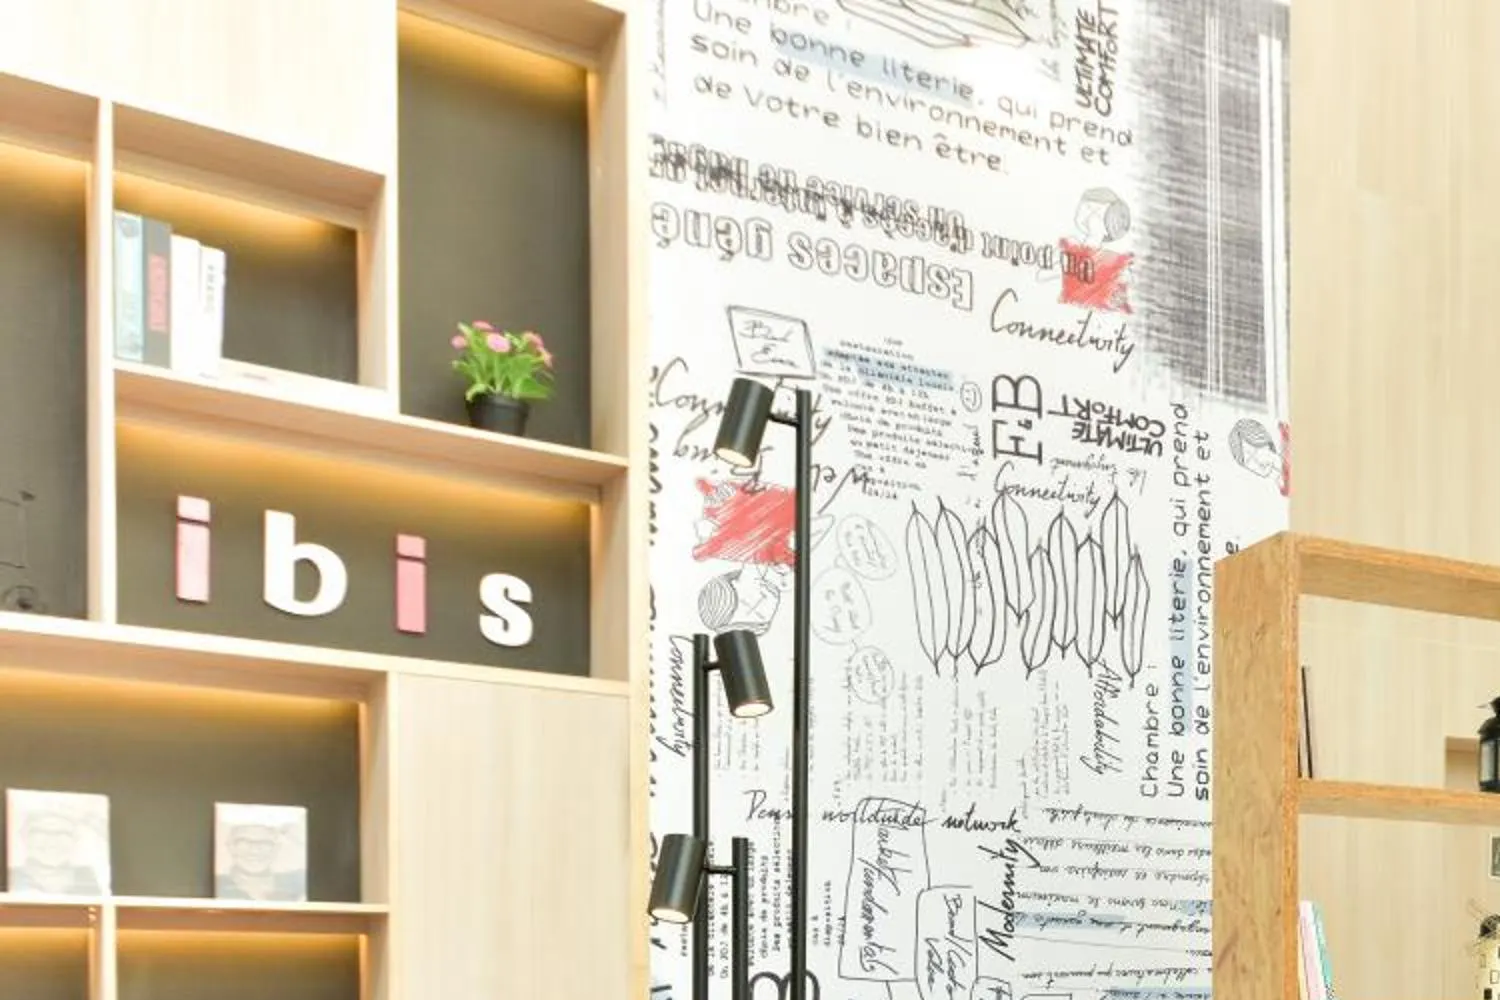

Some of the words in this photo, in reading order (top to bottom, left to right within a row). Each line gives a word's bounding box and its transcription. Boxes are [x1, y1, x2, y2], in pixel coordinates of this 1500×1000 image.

[689, 33, 758, 66] soin
[773, 58, 810, 81] de
[1081, 145, 1110, 166] et
[693, 74, 732, 99] de
[743, 84, 840, 128] Votre
[856, 112, 923, 152] bien
[770, 22, 865, 67] bonne
[998, 95, 1038, 119] qui
[1049, 110, 1133, 147] prend
[991, 288, 1135, 374] Connectivity
[1047, 394, 1166, 439] COMFORT
[1170, 401, 1190, 488] prend
[1195, 430, 1211, 461] et
[1169, 497, 1189, 538] qui
[175, 495, 534, 647] ibis
[1167, 653, 1187, 739] bonne
[1194, 704, 1211, 736] de
[1140, 683, 1160, 798] Chambre
[1167, 748, 1187, 799] Une
[1191, 746, 1210, 801] soin
